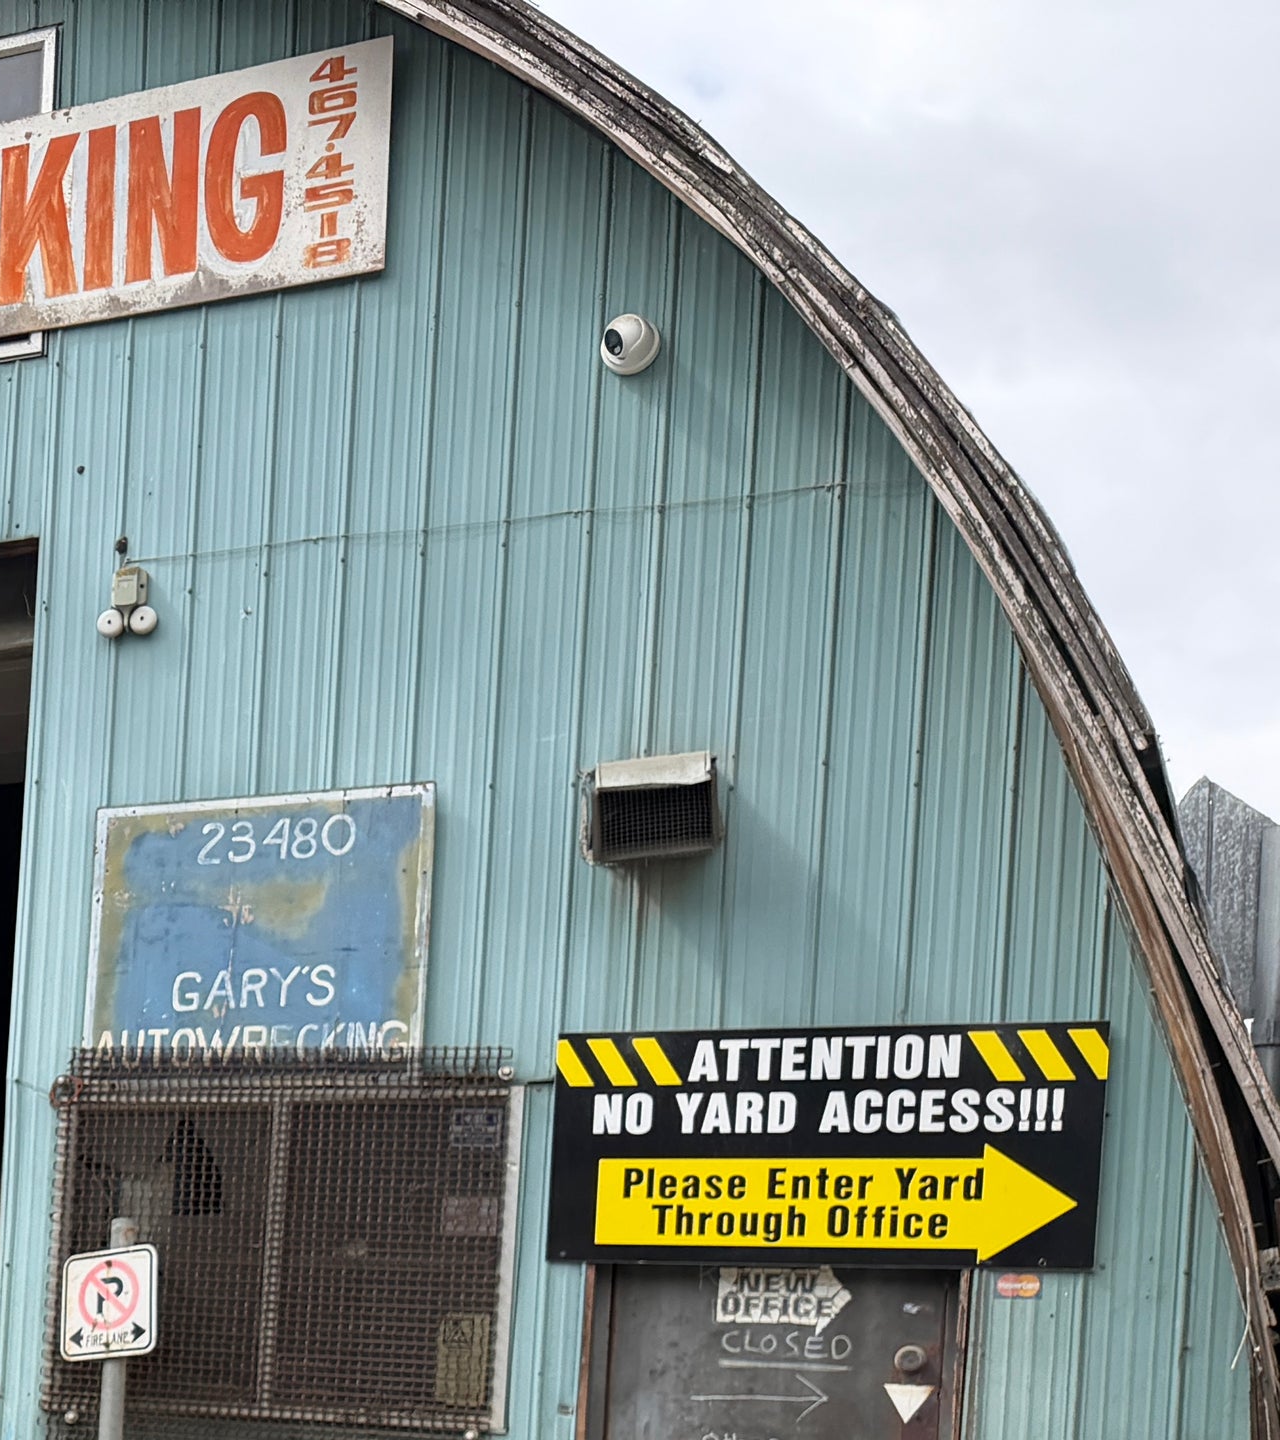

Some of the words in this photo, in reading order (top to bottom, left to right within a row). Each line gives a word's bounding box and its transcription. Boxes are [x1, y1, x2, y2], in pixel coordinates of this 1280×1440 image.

[197, 813, 357, 864] 23480
[171, 964, 337, 1012] GARY'S
[687, 1034, 962, 1082] ATTENTION
[592, 1093, 653, 1136] NO
[677, 1091, 796, 1134] YARD
[818, 1087, 1065, 1134] ACCESS!!!
[623, 1167, 746, 1201] Please
[767, 1167, 874, 1201] Enter
[894, 1167, 984, 1202] Yard
[652, 1204, 806, 1244] Through
[827, 1206, 949, 1239] Office
[720, 1290, 833, 1318] OFFICE
[85, 1334, 103, 1348] FIRE
[722, 1329, 852, 1360] CLOSED
